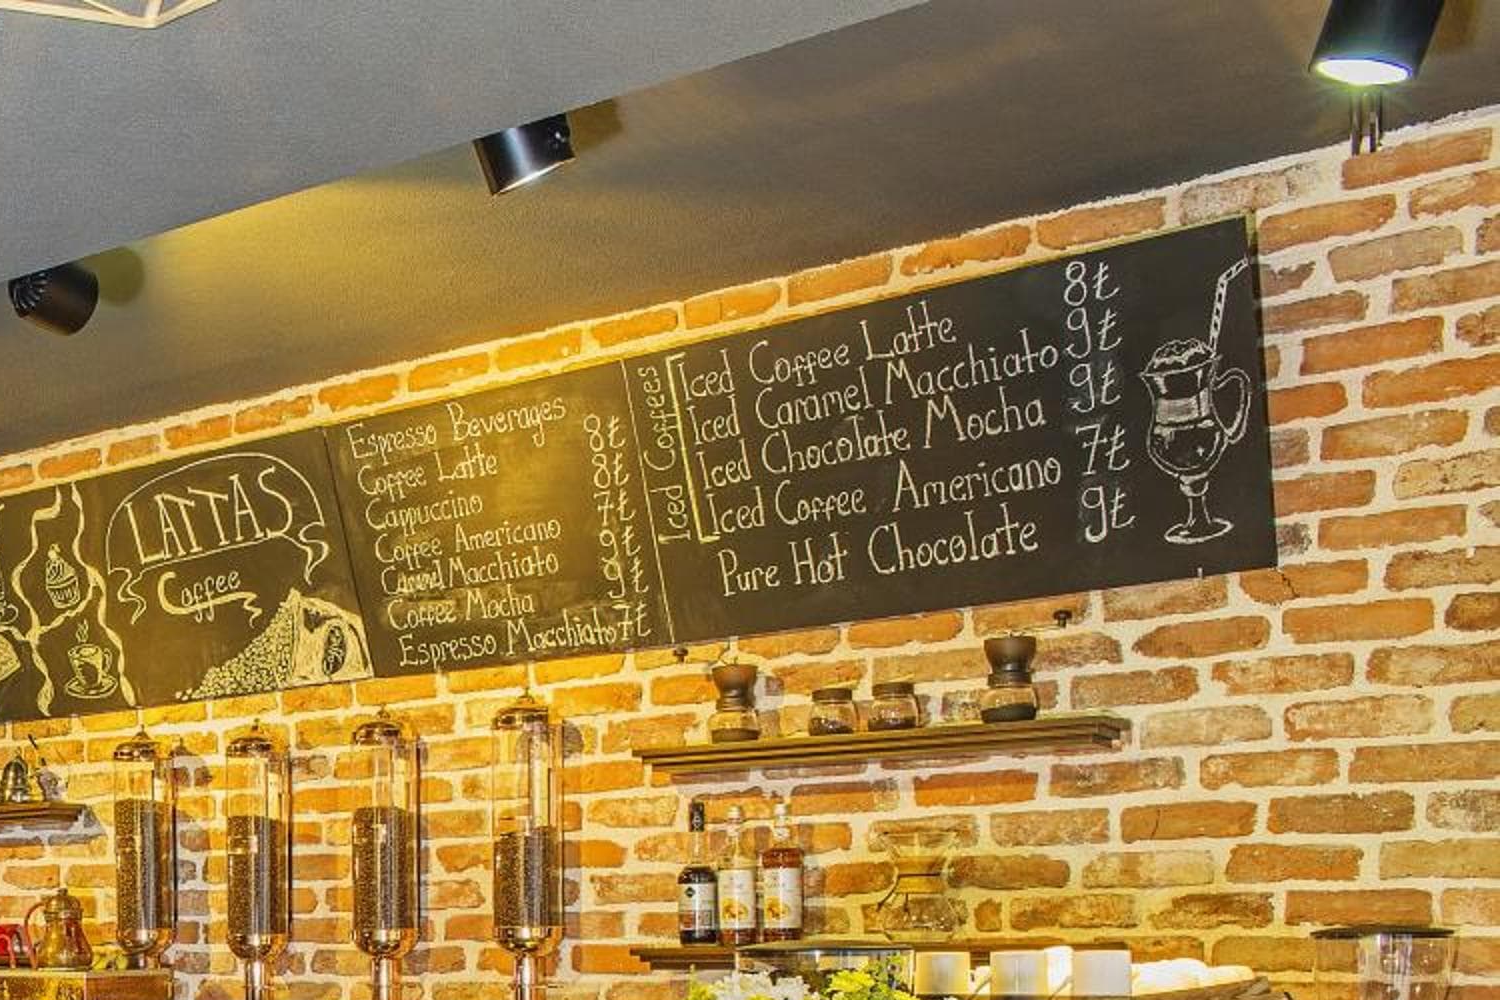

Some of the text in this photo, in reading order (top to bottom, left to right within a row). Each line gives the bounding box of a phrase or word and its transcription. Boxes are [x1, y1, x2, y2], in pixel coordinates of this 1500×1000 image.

[678, 348, 736, 401] Iced
[749, 339, 850, 388] Coffee
[859, 300, 957, 361] Latte
[687, 394, 741, 445] Iced
[756, 365, 874, 429] Caramel
[886, 327, 1059, 405] Macchiato
[346, 397, 566, 465] Espresso Beverages
[637, 365, 691, 544] Iced Coffees
[696, 438, 752, 490] Iced
[761, 409, 911, 474] Chocolate
[924, 386, 1048, 449] Mocha
[357, 465, 428, 502] Coffee
[434, 443, 498, 482] Latte
[706, 485, 765, 535] Iced
[775, 479, 866, 526] Coffee
[892, 456, 1062, 513] Americano
[124, 465, 293, 565] LATTAS
[365, 490, 483, 536] Cappuccino
[375, 533, 442, 571] Coffee
[455, 518, 561, 552] Americano
[448, 545, 559, 589] Macchiato
[718, 549, 781, 597] Pure
[788, 531, 848, 585] Hot
[868, 502, 1039, 575] Chocolate
[157, 570, 242, 623] Coffee
[387, 598, 457, 631] Coffee
[465, 584, 536, 621] Mocha
[399, 634, 497, 670] Espresso
[505, 606, 617, 657] Macchiato
